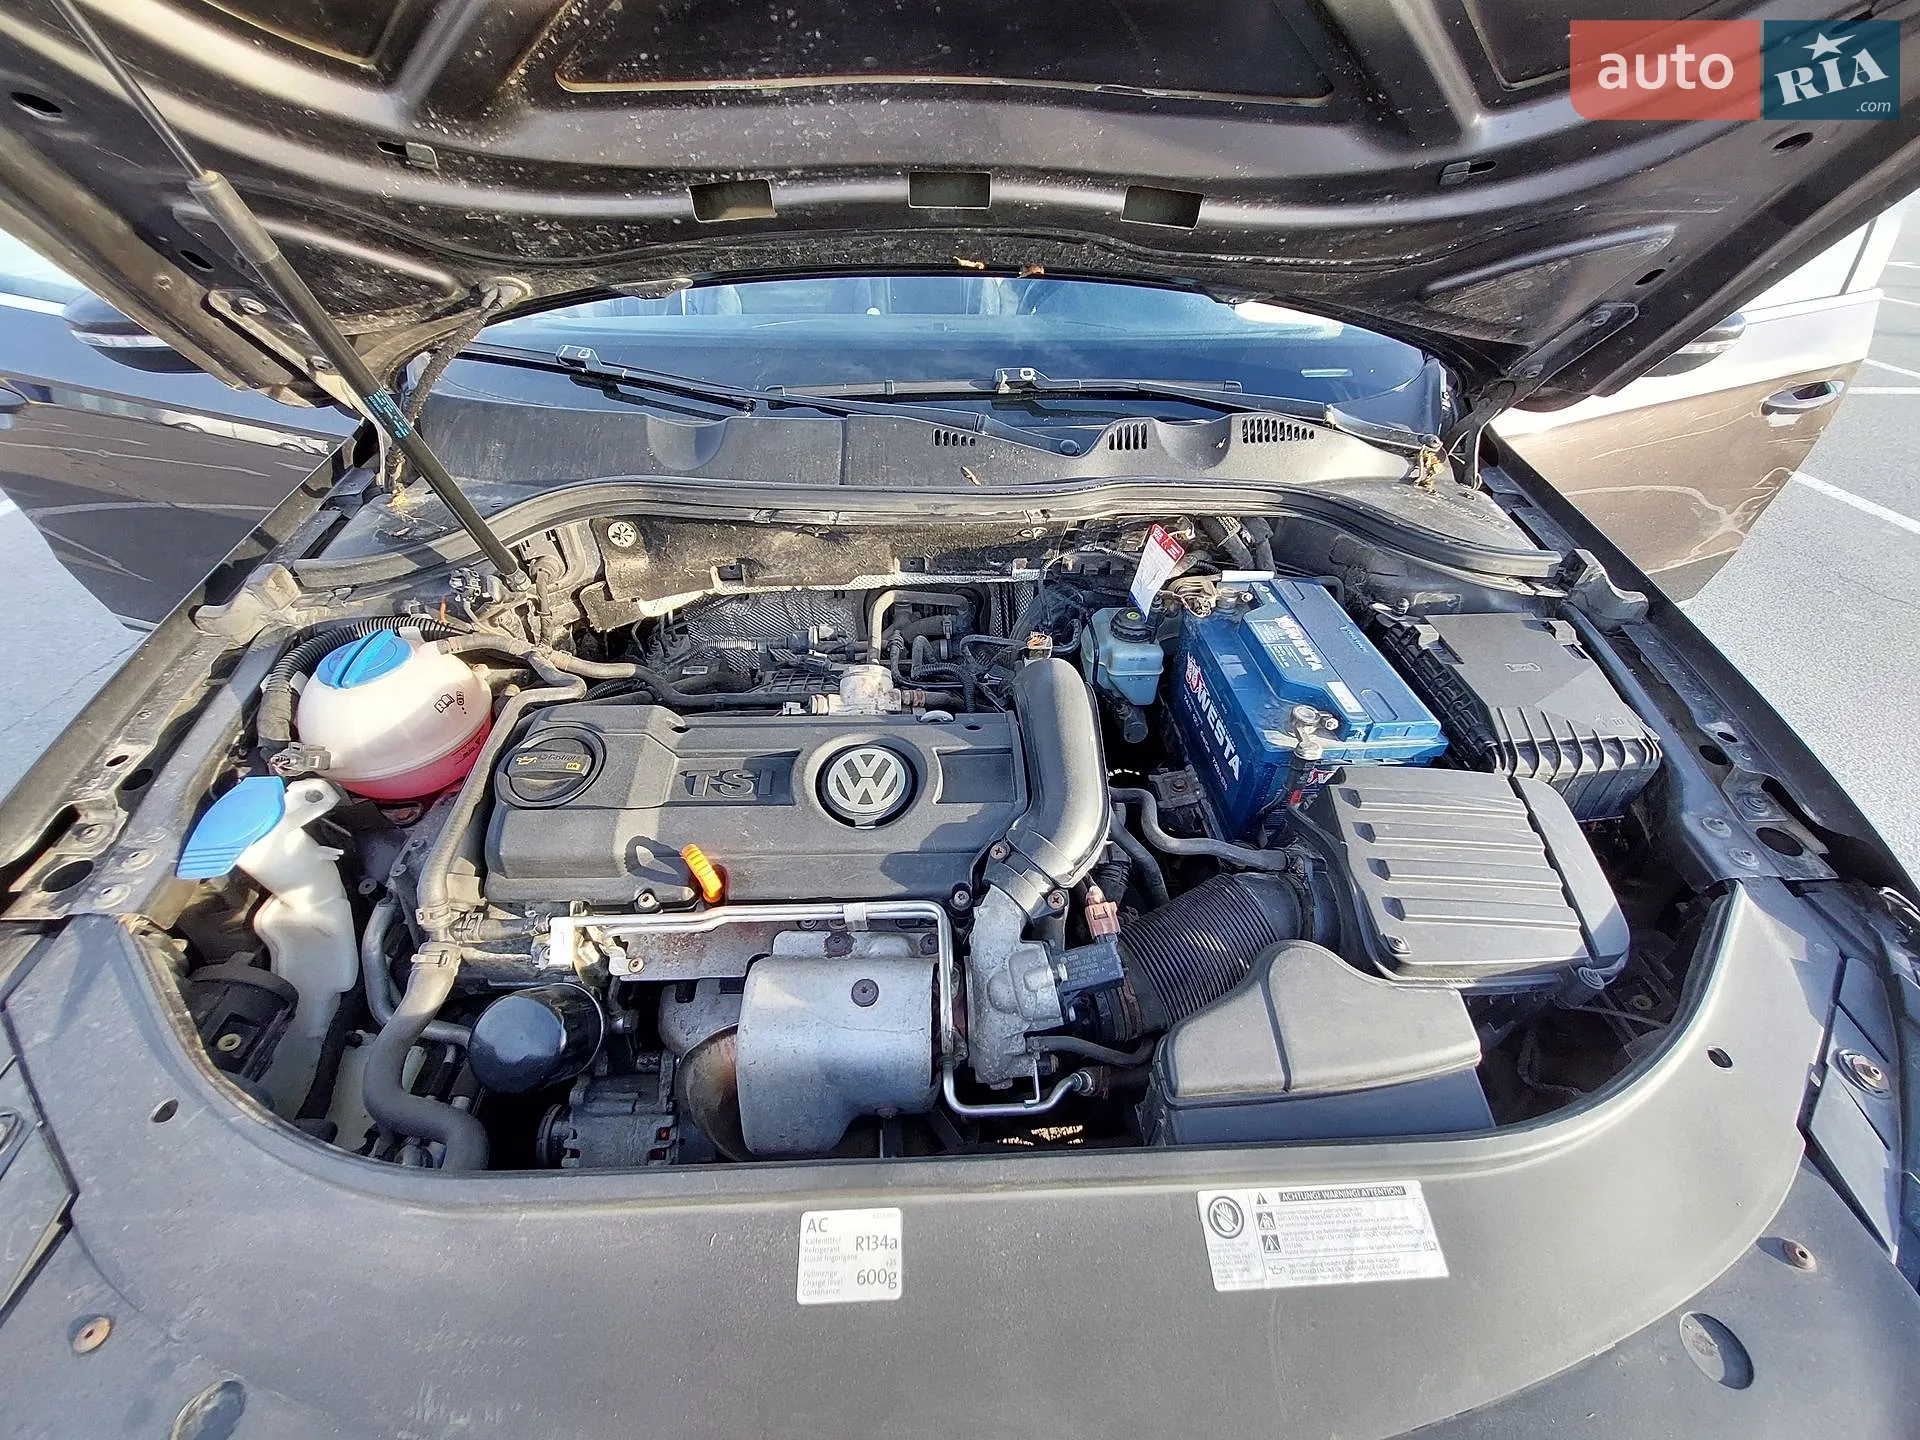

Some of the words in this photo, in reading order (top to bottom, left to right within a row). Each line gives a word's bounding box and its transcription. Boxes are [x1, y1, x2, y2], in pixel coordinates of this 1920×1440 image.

[1197, 684, 1240, 781] WESTA
[684, 769, 773, 798] TSI
[1282, 1191, 1320, 1201] ACHTUNG!
[1321, 1188, 1360, 1200] WARNING!
[1361, 1186, 1406, 1198] ATTENTION!
[806, 1217, 829, 1233] AC
[855, 1234, 898, 1251] R134a
[856, 1268, 898, 1290] 600g
